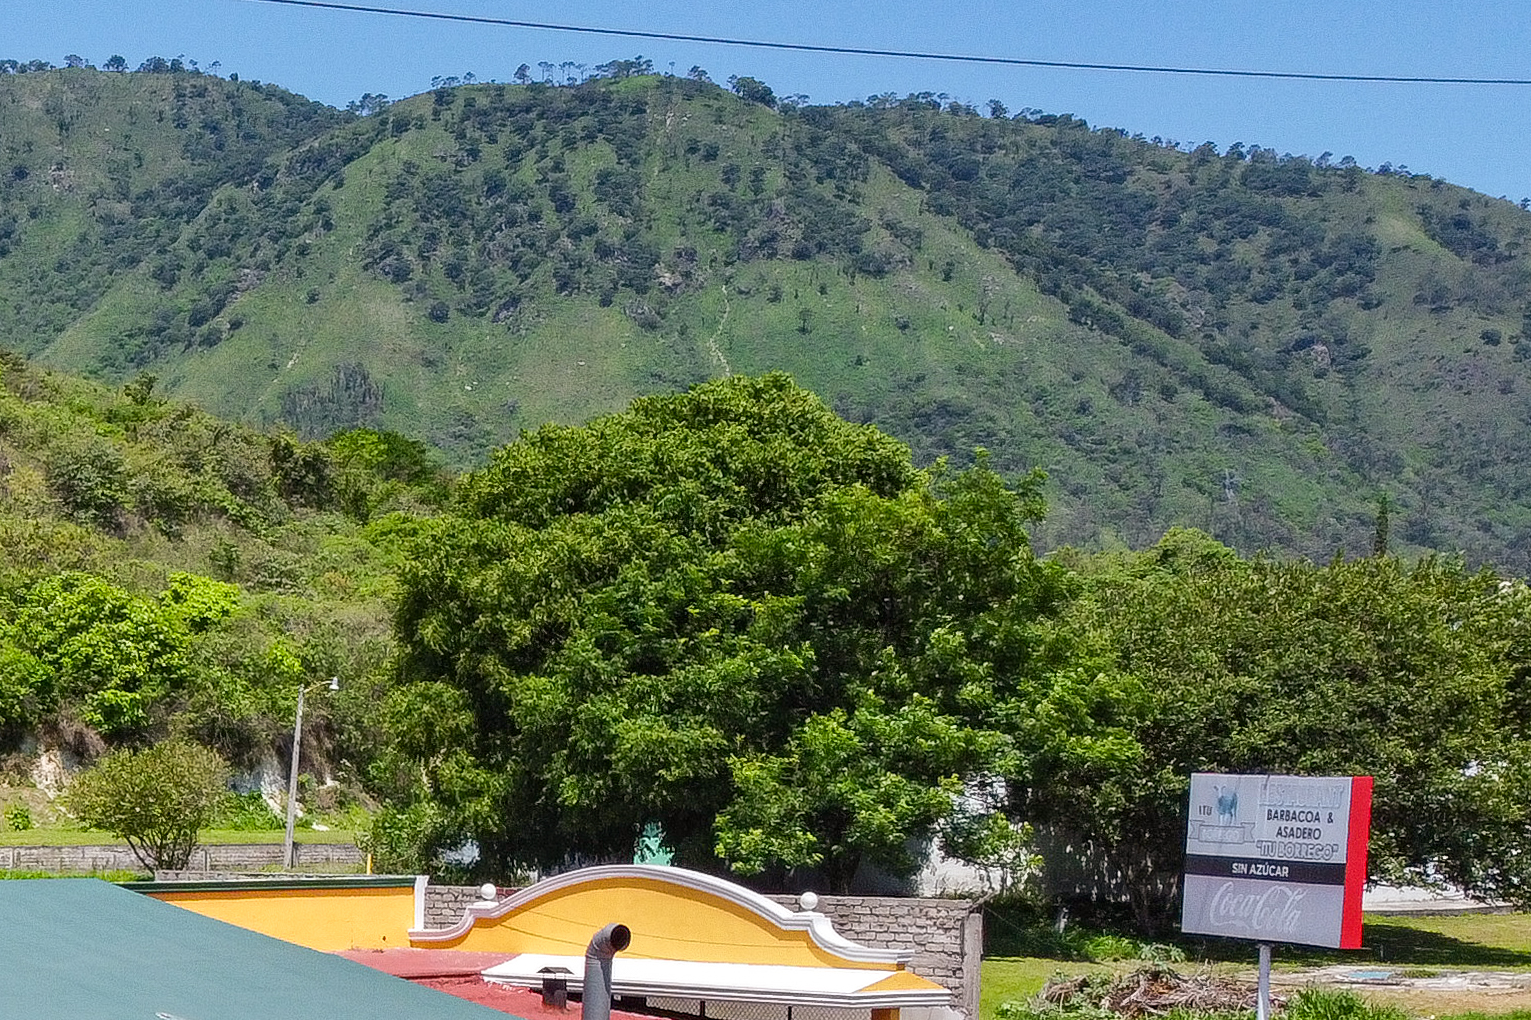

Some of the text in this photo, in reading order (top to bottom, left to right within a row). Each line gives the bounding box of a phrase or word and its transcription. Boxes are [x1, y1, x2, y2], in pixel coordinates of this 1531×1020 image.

[1199, 805, 1212, 817] ITU
[1267, 809, 1334, 824] BARBACOA &
[1276, 826, 1322, 840] ASADERO
[1232, 862, 1289, 878] SIN AZÚCAR
